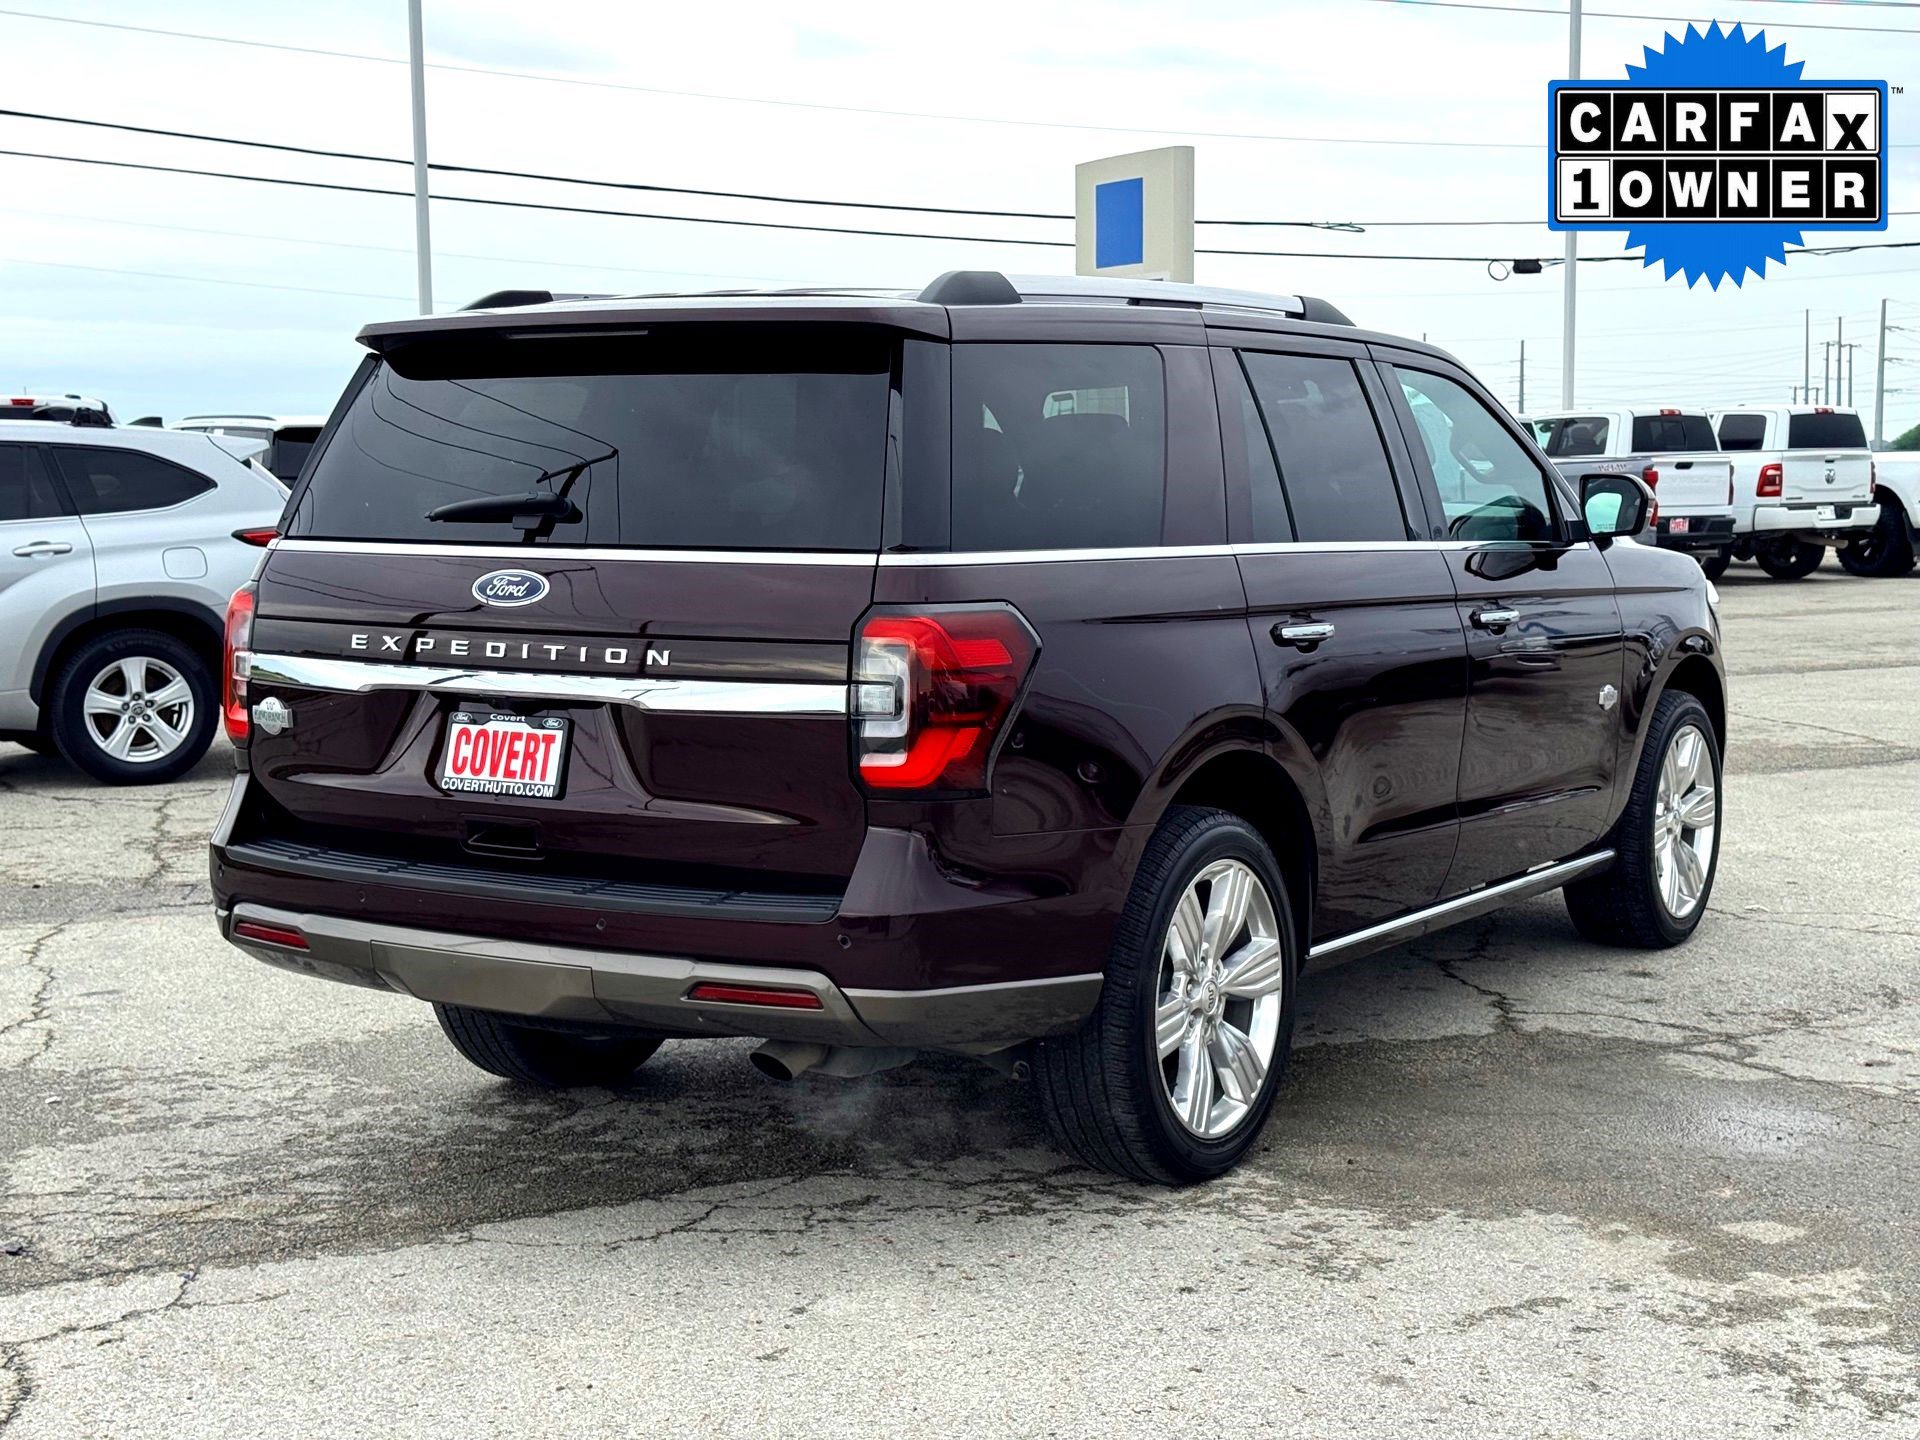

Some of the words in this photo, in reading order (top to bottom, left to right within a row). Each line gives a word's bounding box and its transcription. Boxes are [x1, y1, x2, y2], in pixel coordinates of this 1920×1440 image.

[486, 575, 531, 597] Ford
[351, 633, 671, 666] EXPEDITION
[490, 713, 526, 722] Covert
[451, 726, 557, 782] COVERT
[441, 777, 554, 798] COVERTHUTTO.COM
